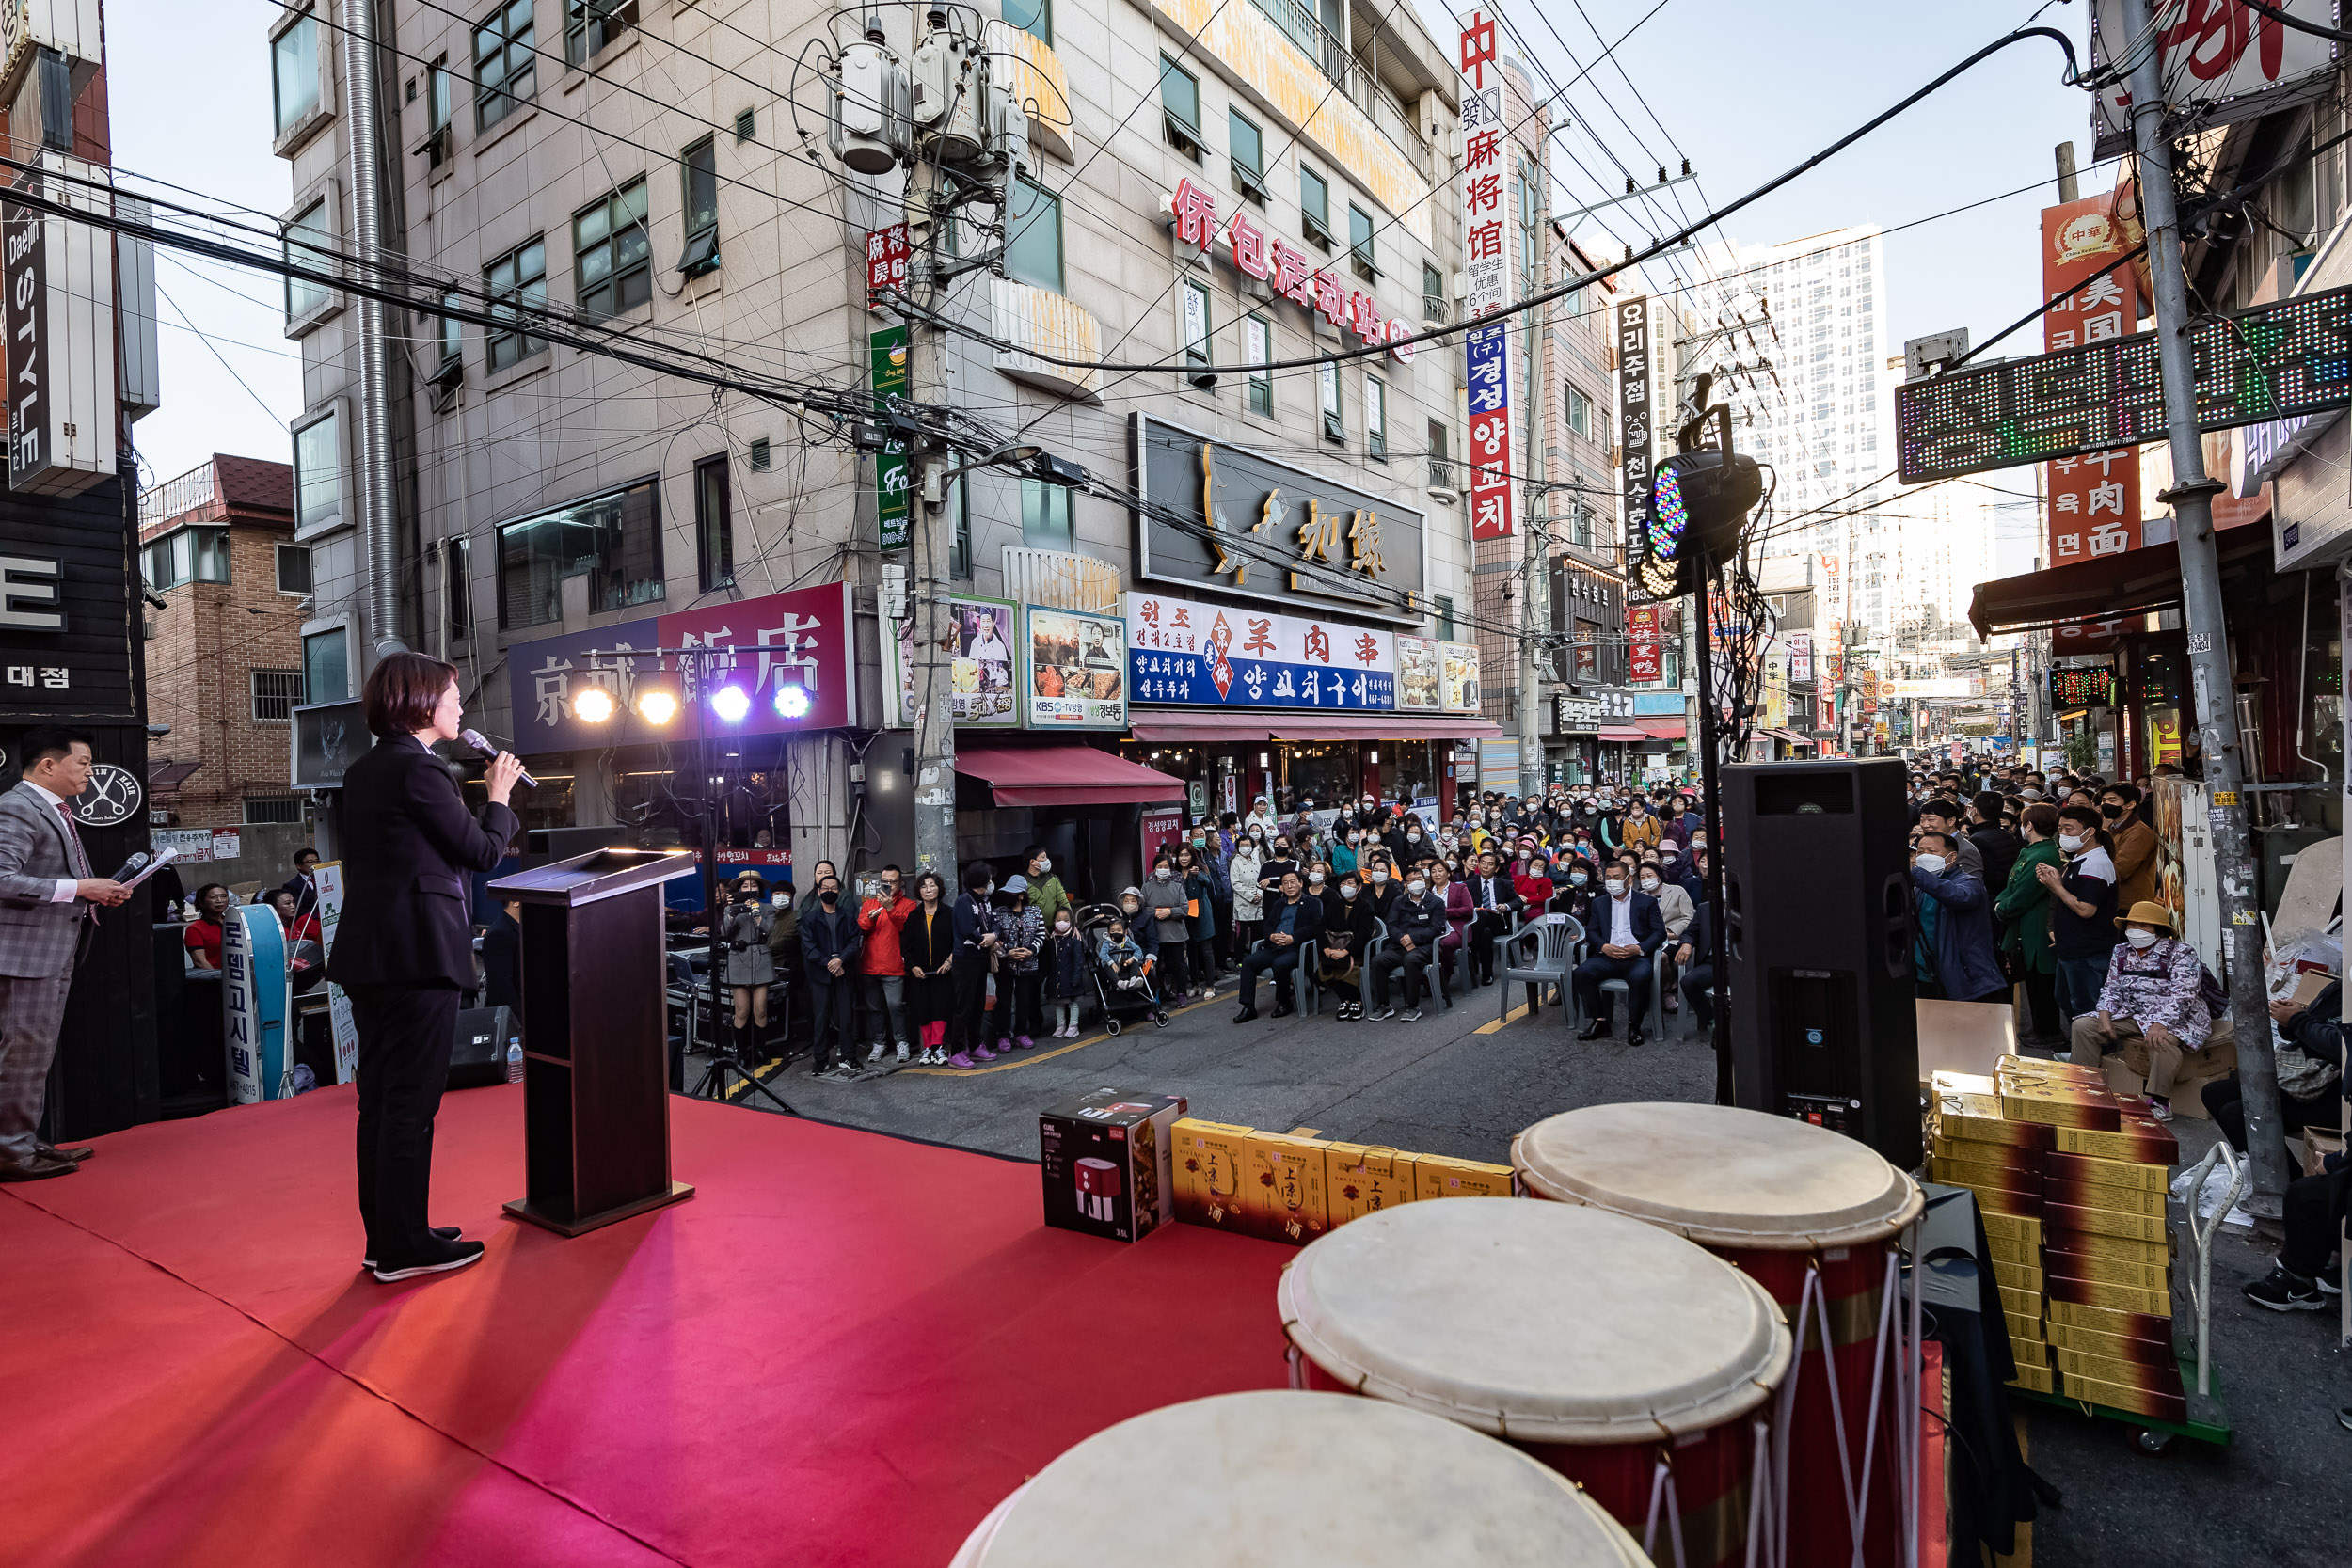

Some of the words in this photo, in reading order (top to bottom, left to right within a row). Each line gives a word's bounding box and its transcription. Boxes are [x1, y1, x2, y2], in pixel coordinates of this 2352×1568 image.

[1460, 11, 1497, 91] 中
[1464, 128, 1503, 261] 麻将馆
[8, 215, 40, 267] Daejin
[869, 226, 905, 261] 麻将
[2072, 226, 2103, 241] 中華
[2065, 249, 2082, 258] China
[2081, 243, 2110, 256] Restaurant
[1468, 256, 1504, 279] 留学生
[1473, 274, 1499, 293] 优惠
[1470, 326, 1502, 345] 원조
[1472, 339, 1502, 359] (구)
[16, 266, 40, 472] STYLE
[1622, 303, 1646, 404] 요리주점
[1470, 356, 1503, 411] 경성
[1472, 418, 1508, 533] 양꼬치
[1572, 577, 1609, 607] 천수호프
[1139, 600, 1191, 629] 원조
[1243, 618, 1379, 668] 羊肉串
[1243, 664, 1367, 706] 양꼬치구이
[1036, 701, 1054, 712] KBS
[119, 775, 136, 796] HAIR
[1148, 818, 1179, 833] 경성양꼬치
[225, 921, 251, 1079] 로뎀고시텔
